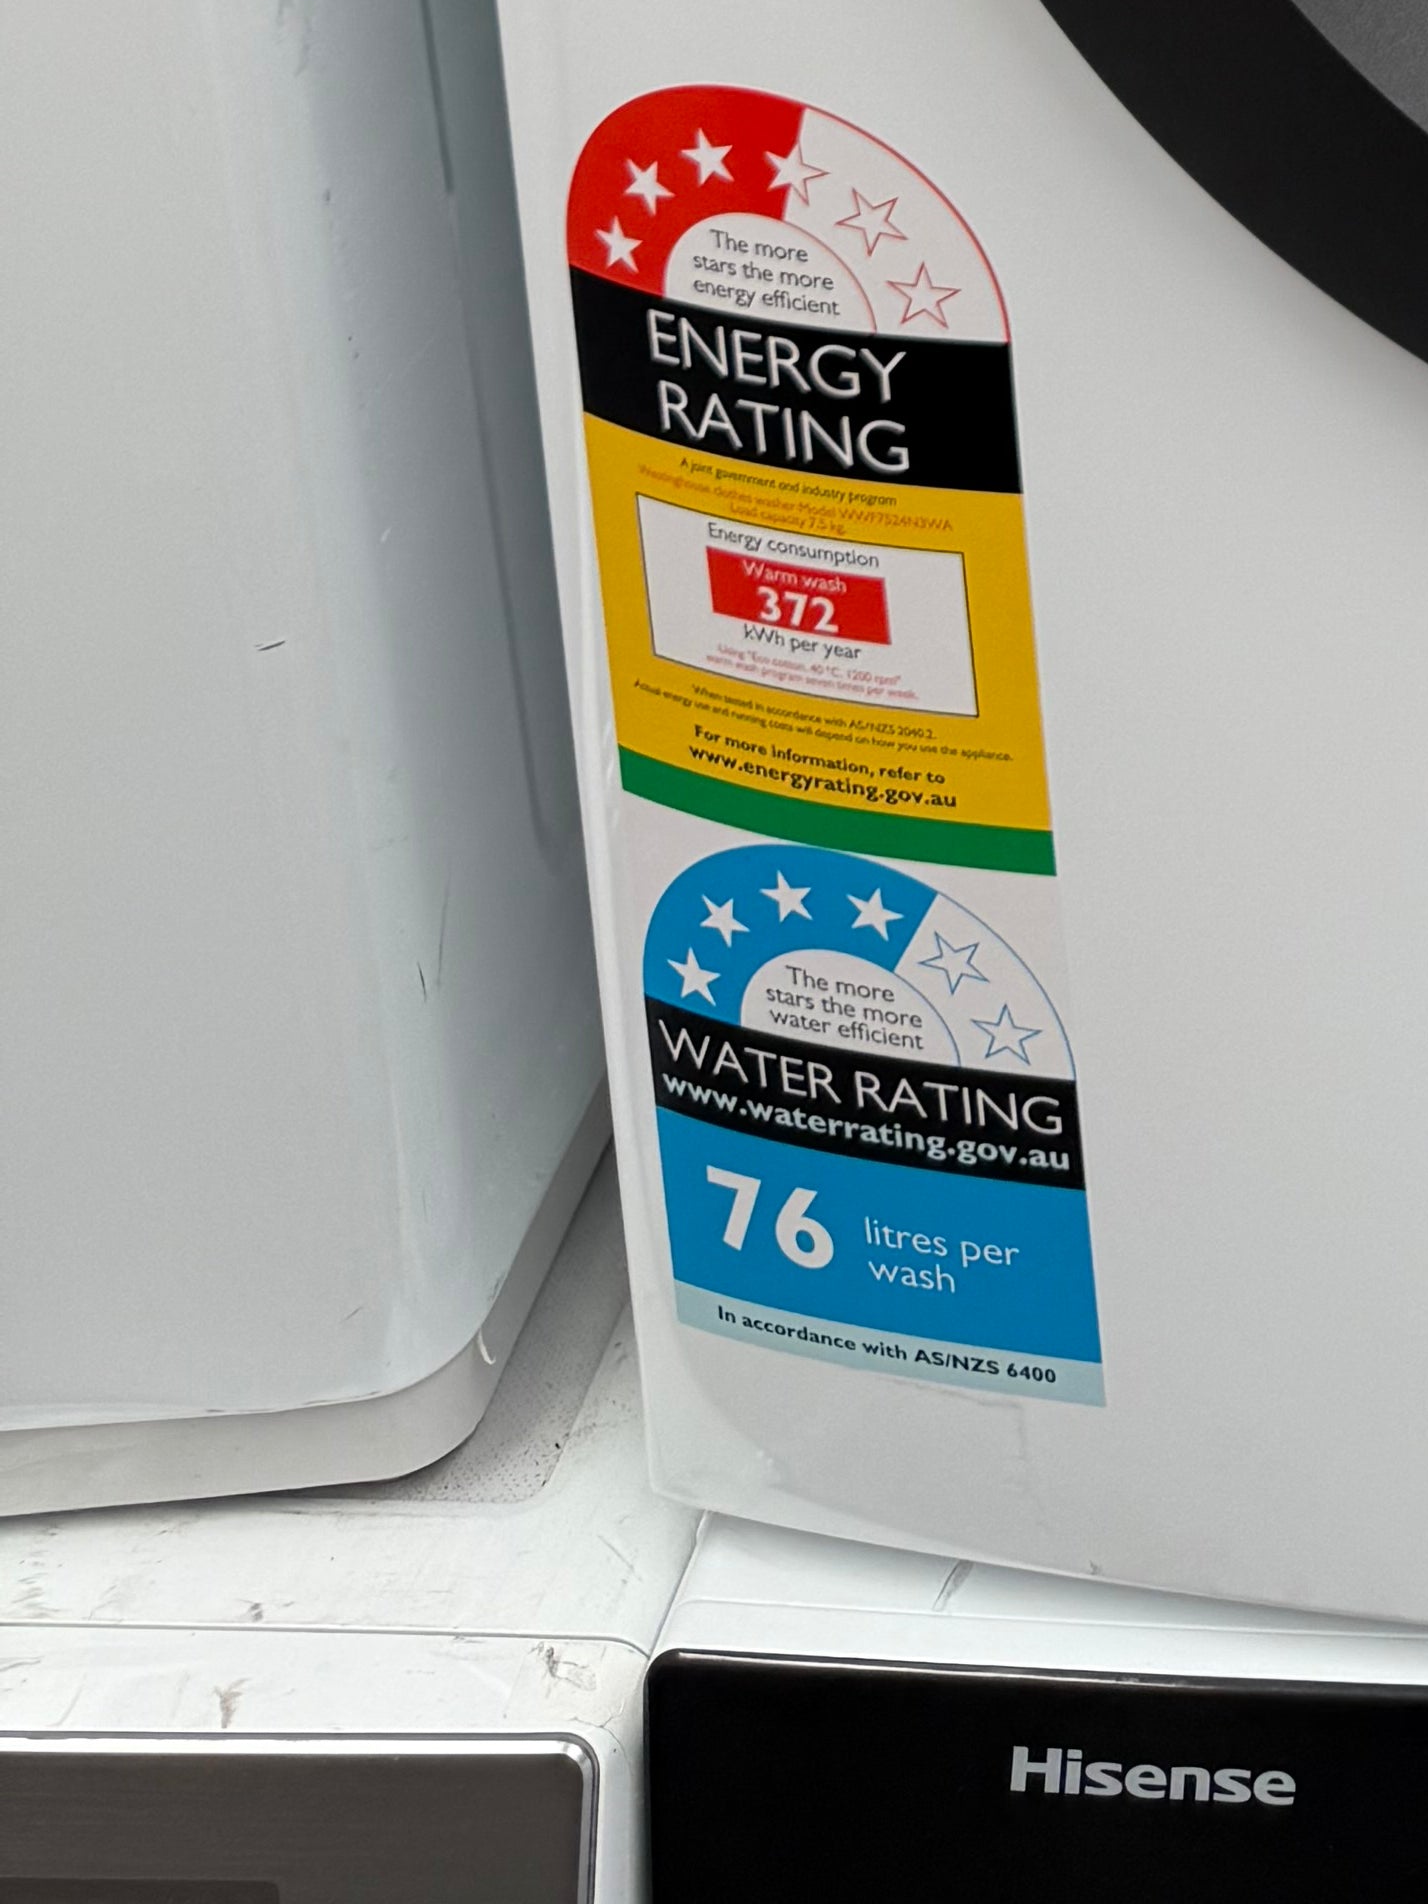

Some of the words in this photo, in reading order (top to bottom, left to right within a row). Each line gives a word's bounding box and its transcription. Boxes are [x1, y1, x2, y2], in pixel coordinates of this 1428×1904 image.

[710, 228, 748, 253] The
[755, 243, 808, 262] more
[693, 255, 737, 275] stars
[742, 261, 773, 281] the
[780, 271, 834, 290] more
[693, 279, 756, 308] energy
[762, 289, 840, 316] efficient
[646, 308, 907, 404] ENERGY
[657, 379, 911, 474] RATING
[802, 484, 845, 503] industry
[848, 492, 897, 506] program
[708, 522, 762, 552] Energy
[767, 539, 880, 568] consumption
[742, 559, 798, 585] Warm
[801, 576, 847, 593] wash
[757, 586, 839, 633] 372
[744, 623, 785, 646] kWh
[790, 635, 818, 652] per
[824, 643, 862, 660] year
[688, 744, 957, 808] www.energyrating.gov.au
[694, 724, 721, 742] For
[725, 733, 768, 756] more
[771, 745, 875, 778] information,
[878, 766, 921, 784] refer
[926, 770, 945, 785] to
[785, 965, 829, 991] The
[836, 981, 895, 1002] more
[766, 988, 815, 1010] stars
[821, 997, 856, 1018] the
[863, 1006, 922, 1028] more
[769, 1010, 831, 1033] water
[837, 1021, 924, 1050] efficient
[658, 1019, 842, 1105] WATER
[853, 1070, 1063, 1136] RATING
[662, 1073, 1070, 1171] www.waterrating.gov.au
[705, 1164, 835, 1271] 76
[863, 1216, 948, 1258] litres
[960, 1240, 1020, 1268] per
[868, 1260, 956, 1294] wash
[717, 1305, 737, 1324] In
[741, 1314, 857, 1353] accordance
[862, 1340, 908, 1361] with
[914, 1349, 1000, 1375] AS/NZS
[1006, 1361, 1057, 1384] 6400
[1010, 1745, 1297, 1807] Hisense
